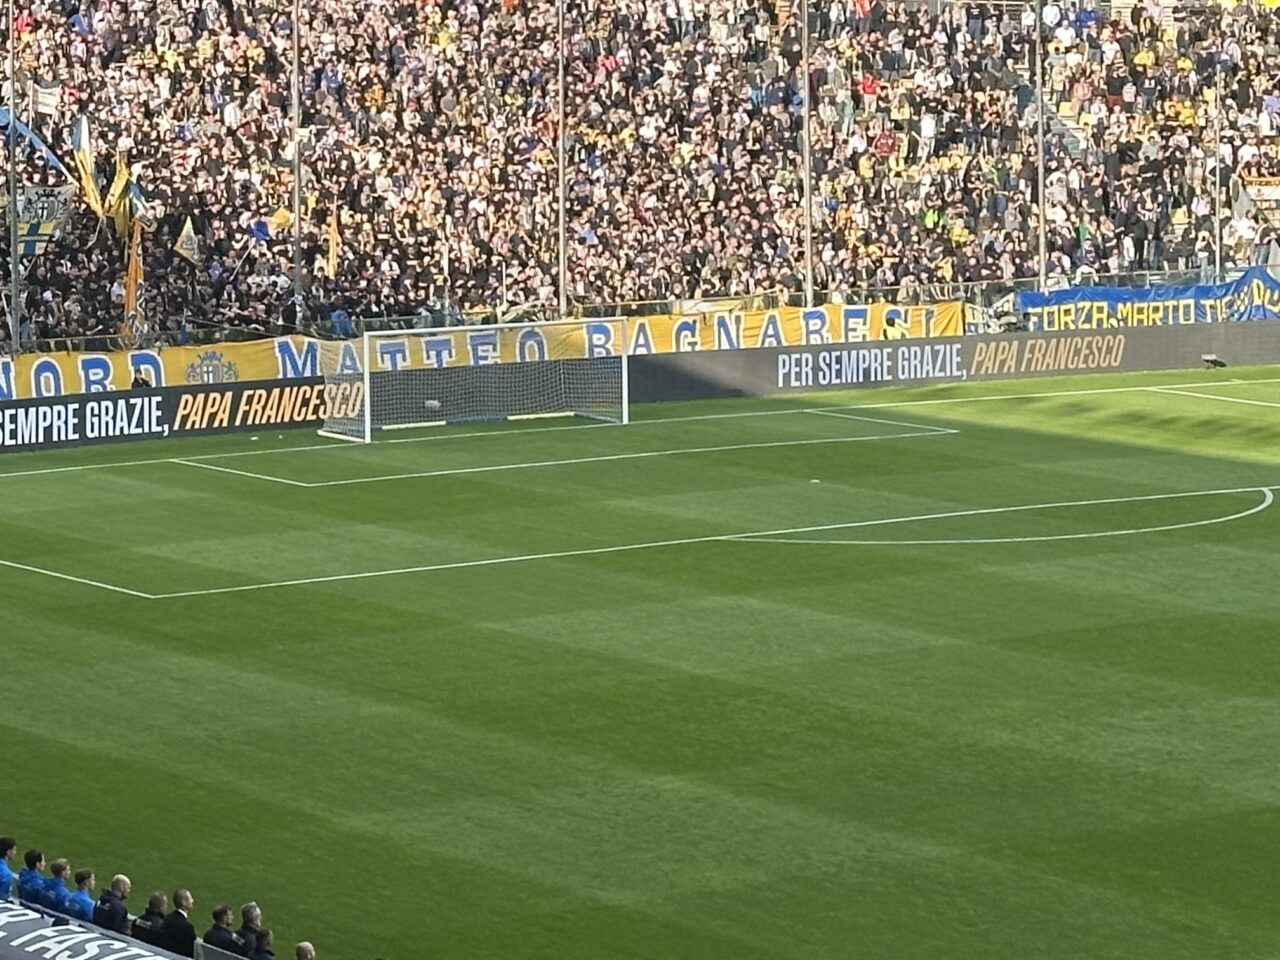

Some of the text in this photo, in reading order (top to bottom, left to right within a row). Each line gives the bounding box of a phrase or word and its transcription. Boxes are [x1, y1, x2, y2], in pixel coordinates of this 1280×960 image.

[1026, 301, 1109, 332] FORZA
[1117, 298, 1195, 328] MARTO
[777, 335, 1125, 388] PER SEMPRE GRAZIE, PAPA FRANCESCO
[85, 396, 170, 439] GRAZIE,
[173, 392, 231, 431] PAPA
[236, 382, 365, 424] FRANCESCO
